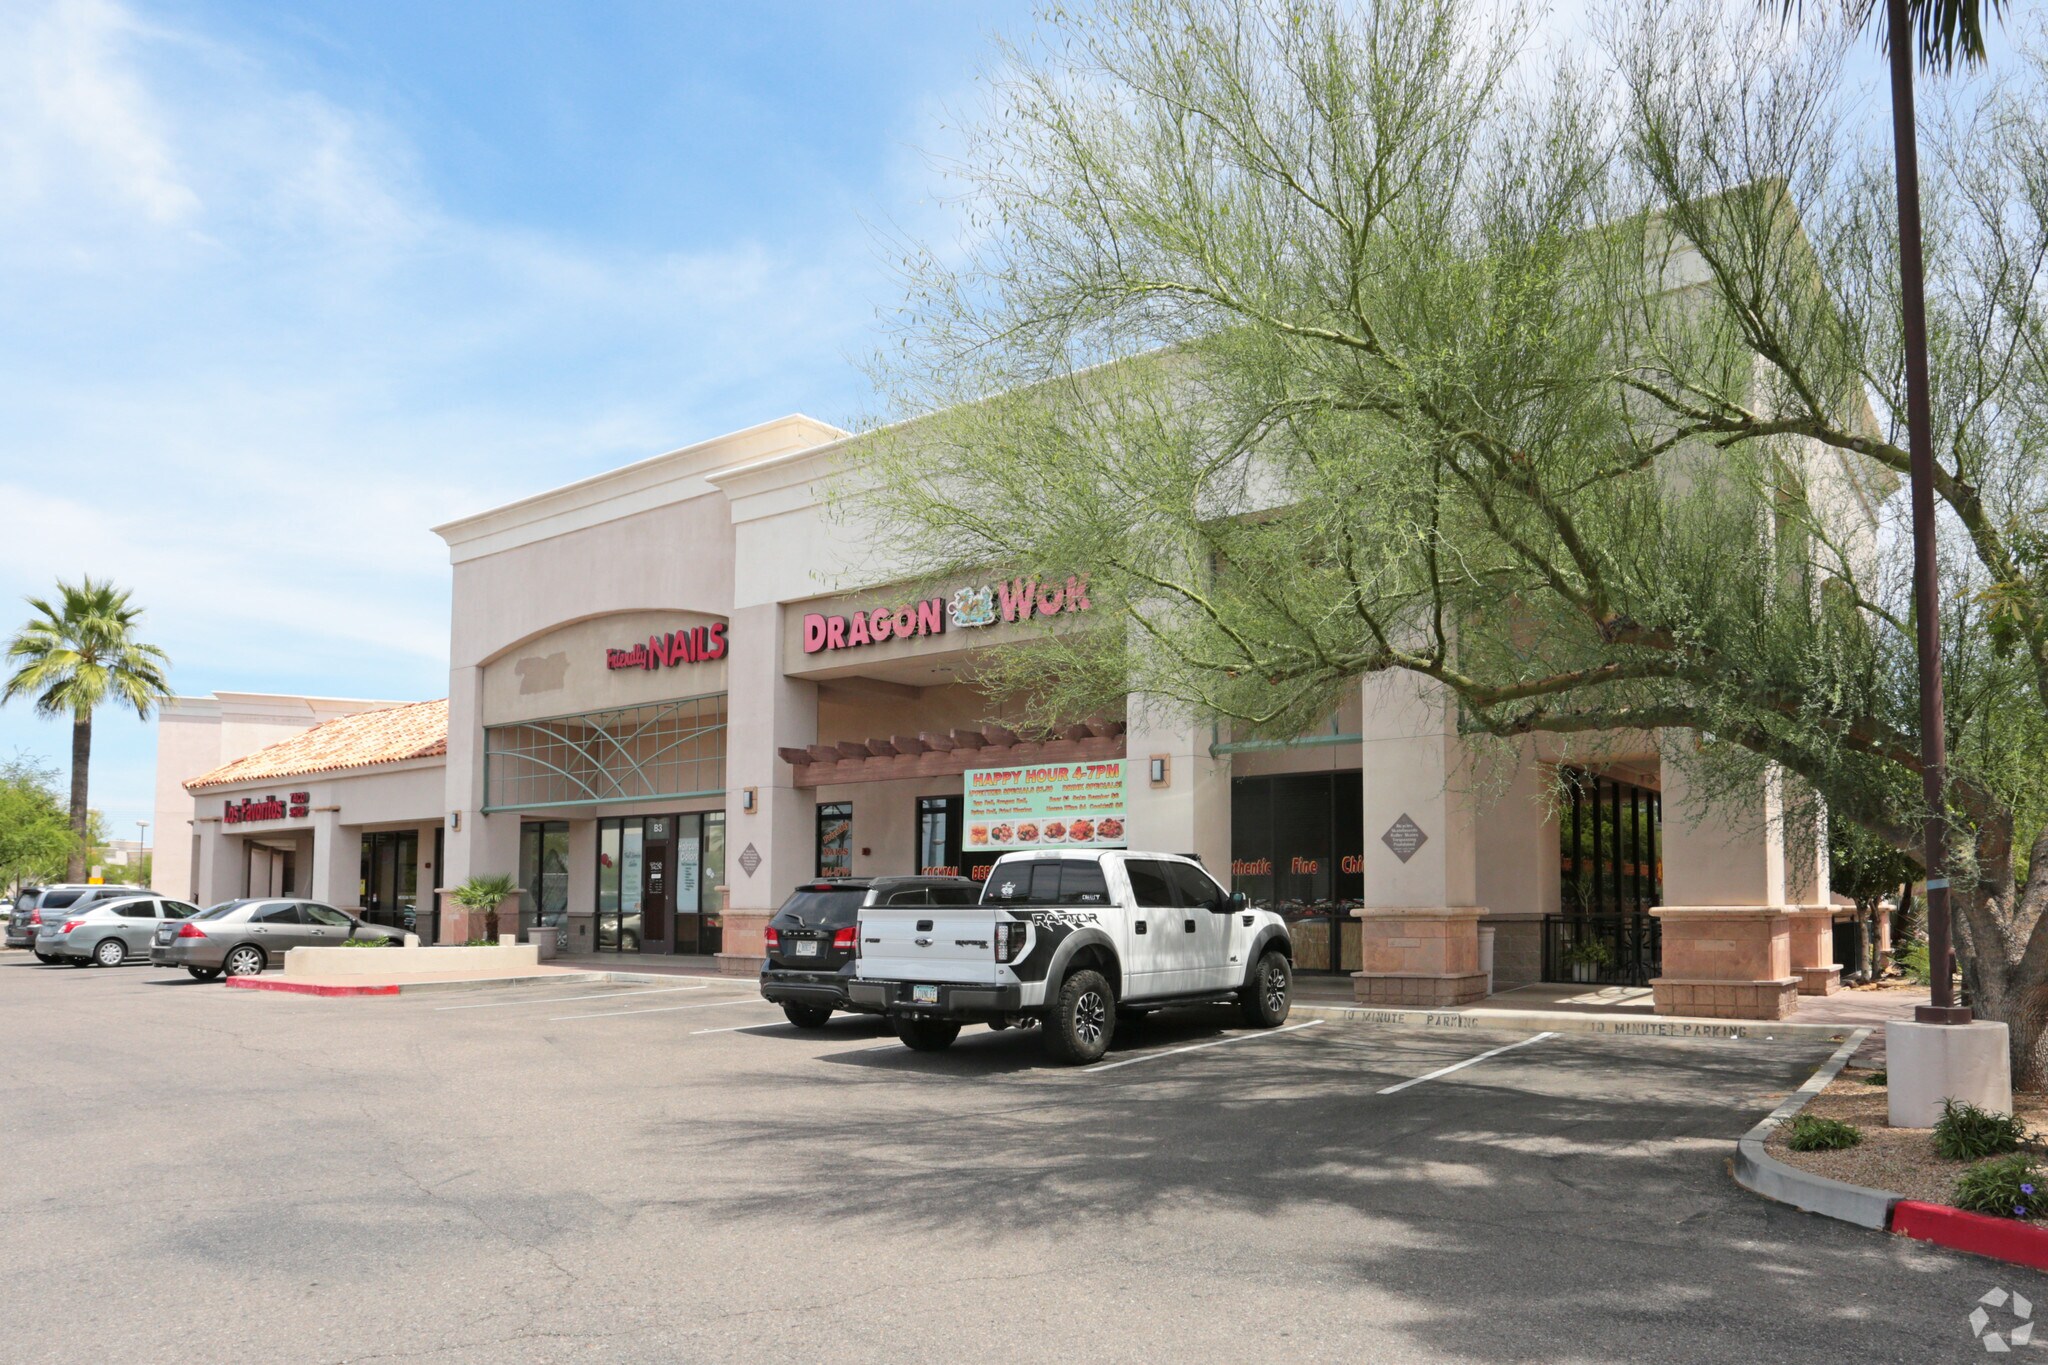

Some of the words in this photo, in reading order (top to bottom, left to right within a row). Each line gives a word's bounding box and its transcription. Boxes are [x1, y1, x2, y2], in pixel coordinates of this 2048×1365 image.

[803, 597, 946, 653] DRAGON
[998, 572, 1091, 622] WOK
[606, 643, 649, 670] Friendly
[648, 622, 728, 669] NAILS
[973, 770, 1022, 787] HAPPY
[1025, 767, 1069, 783] HOUR
[1072, 763, 1120, 780] 4-7PM
[224, 800, 239, 823] Los
[241, 796, 286, 822] Favoritos
[653, 823, 663, 833] B3
[971, 864, 995, 880] BEE
[1291, 856, 1318, 875] Fine
[1032, 912, 1103, 932] RAPTOR
[1362, 1010, 1405, 1024] MINUTE
[1426, 1014, 1479, 1028] PARKING
[1614, 1023, 1667, 1036] MINUTE
[1683, 1023, 1747, 1038] PARKING
